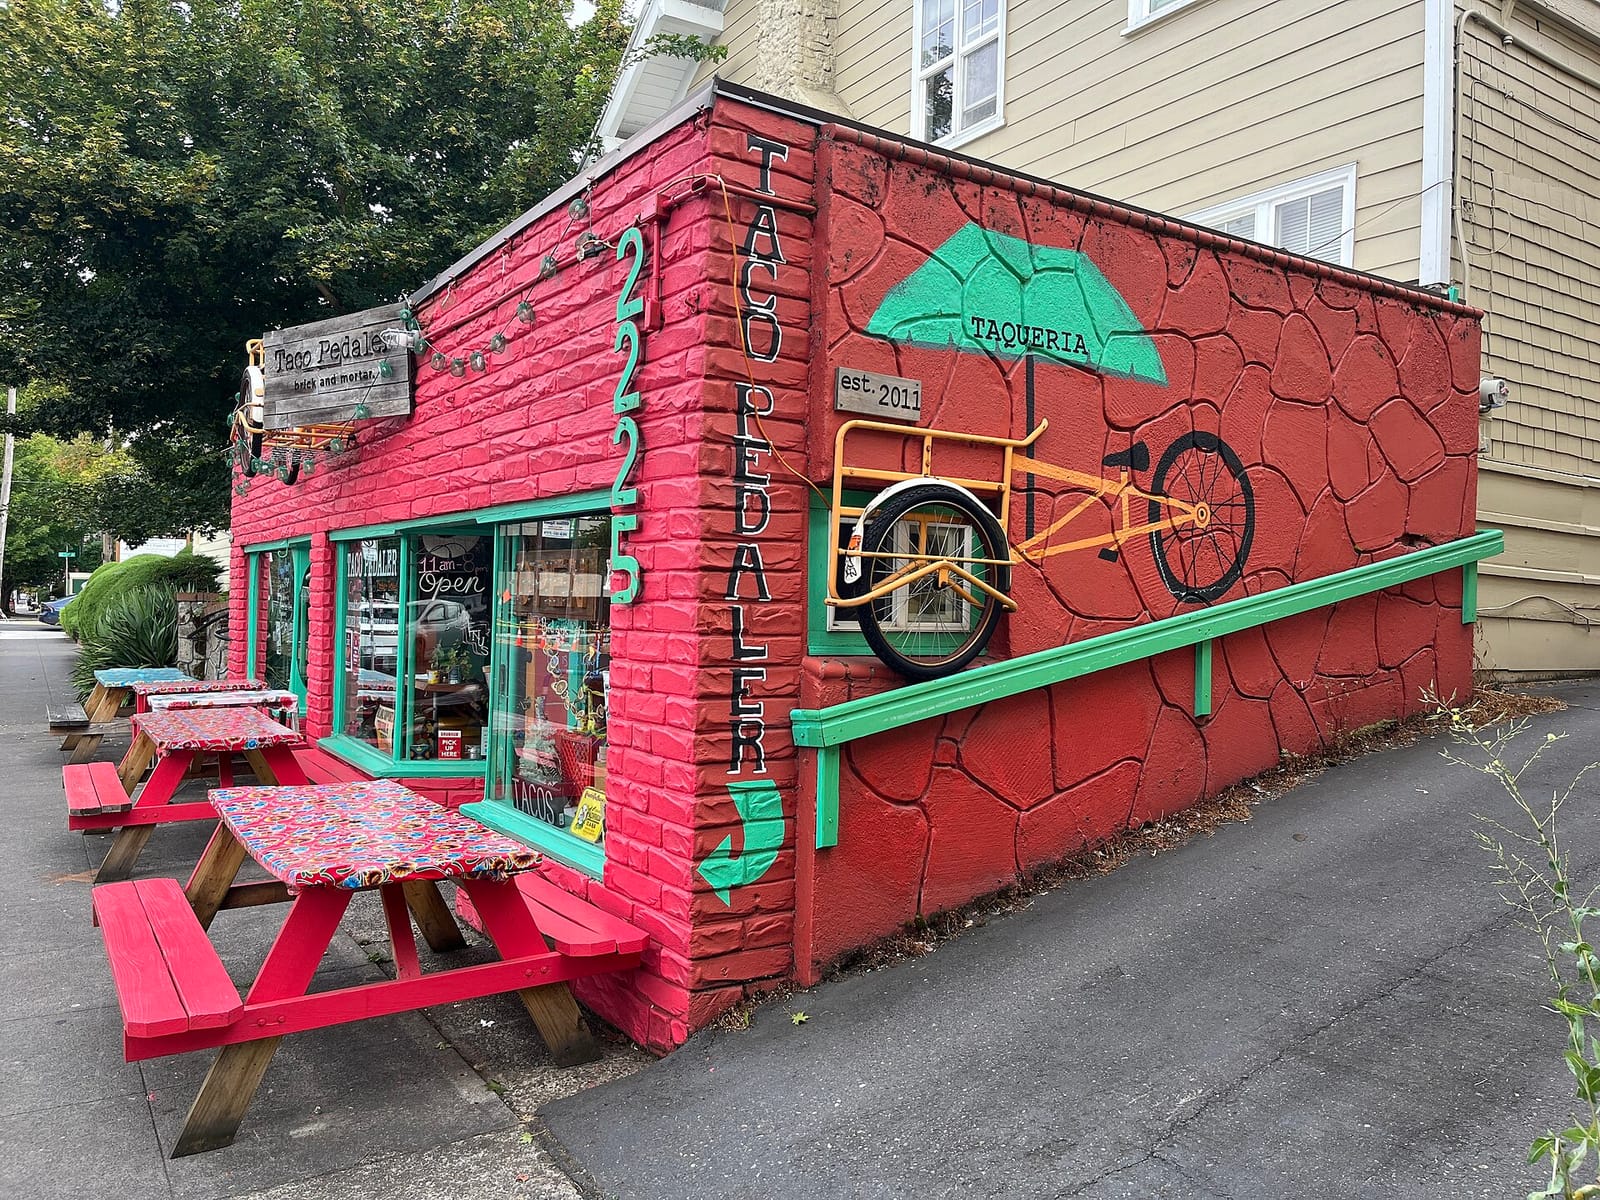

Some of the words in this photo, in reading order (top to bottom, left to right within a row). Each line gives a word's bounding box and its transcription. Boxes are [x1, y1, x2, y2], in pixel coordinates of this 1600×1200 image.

[741, 134, 788, 363] TACO
[971, 316, 1089, 355] TAQUERIA
[275, 348, 312, 373] Taco
[294, 377, 316, 391] brick
[320, 373, 336, 387] and
[841, 374, 876, 394] est.
[878, 384, 921, 411] 2011
[610, 227, 644, 604] 22225
[347, 552, 363, 578] TACO
[364, 549, 397, 577] PEDALER
[725, 382, 774, 774] PEDALER
[419, 572, 486, 601] Open
[512, 778, 555, 825] TACOS
